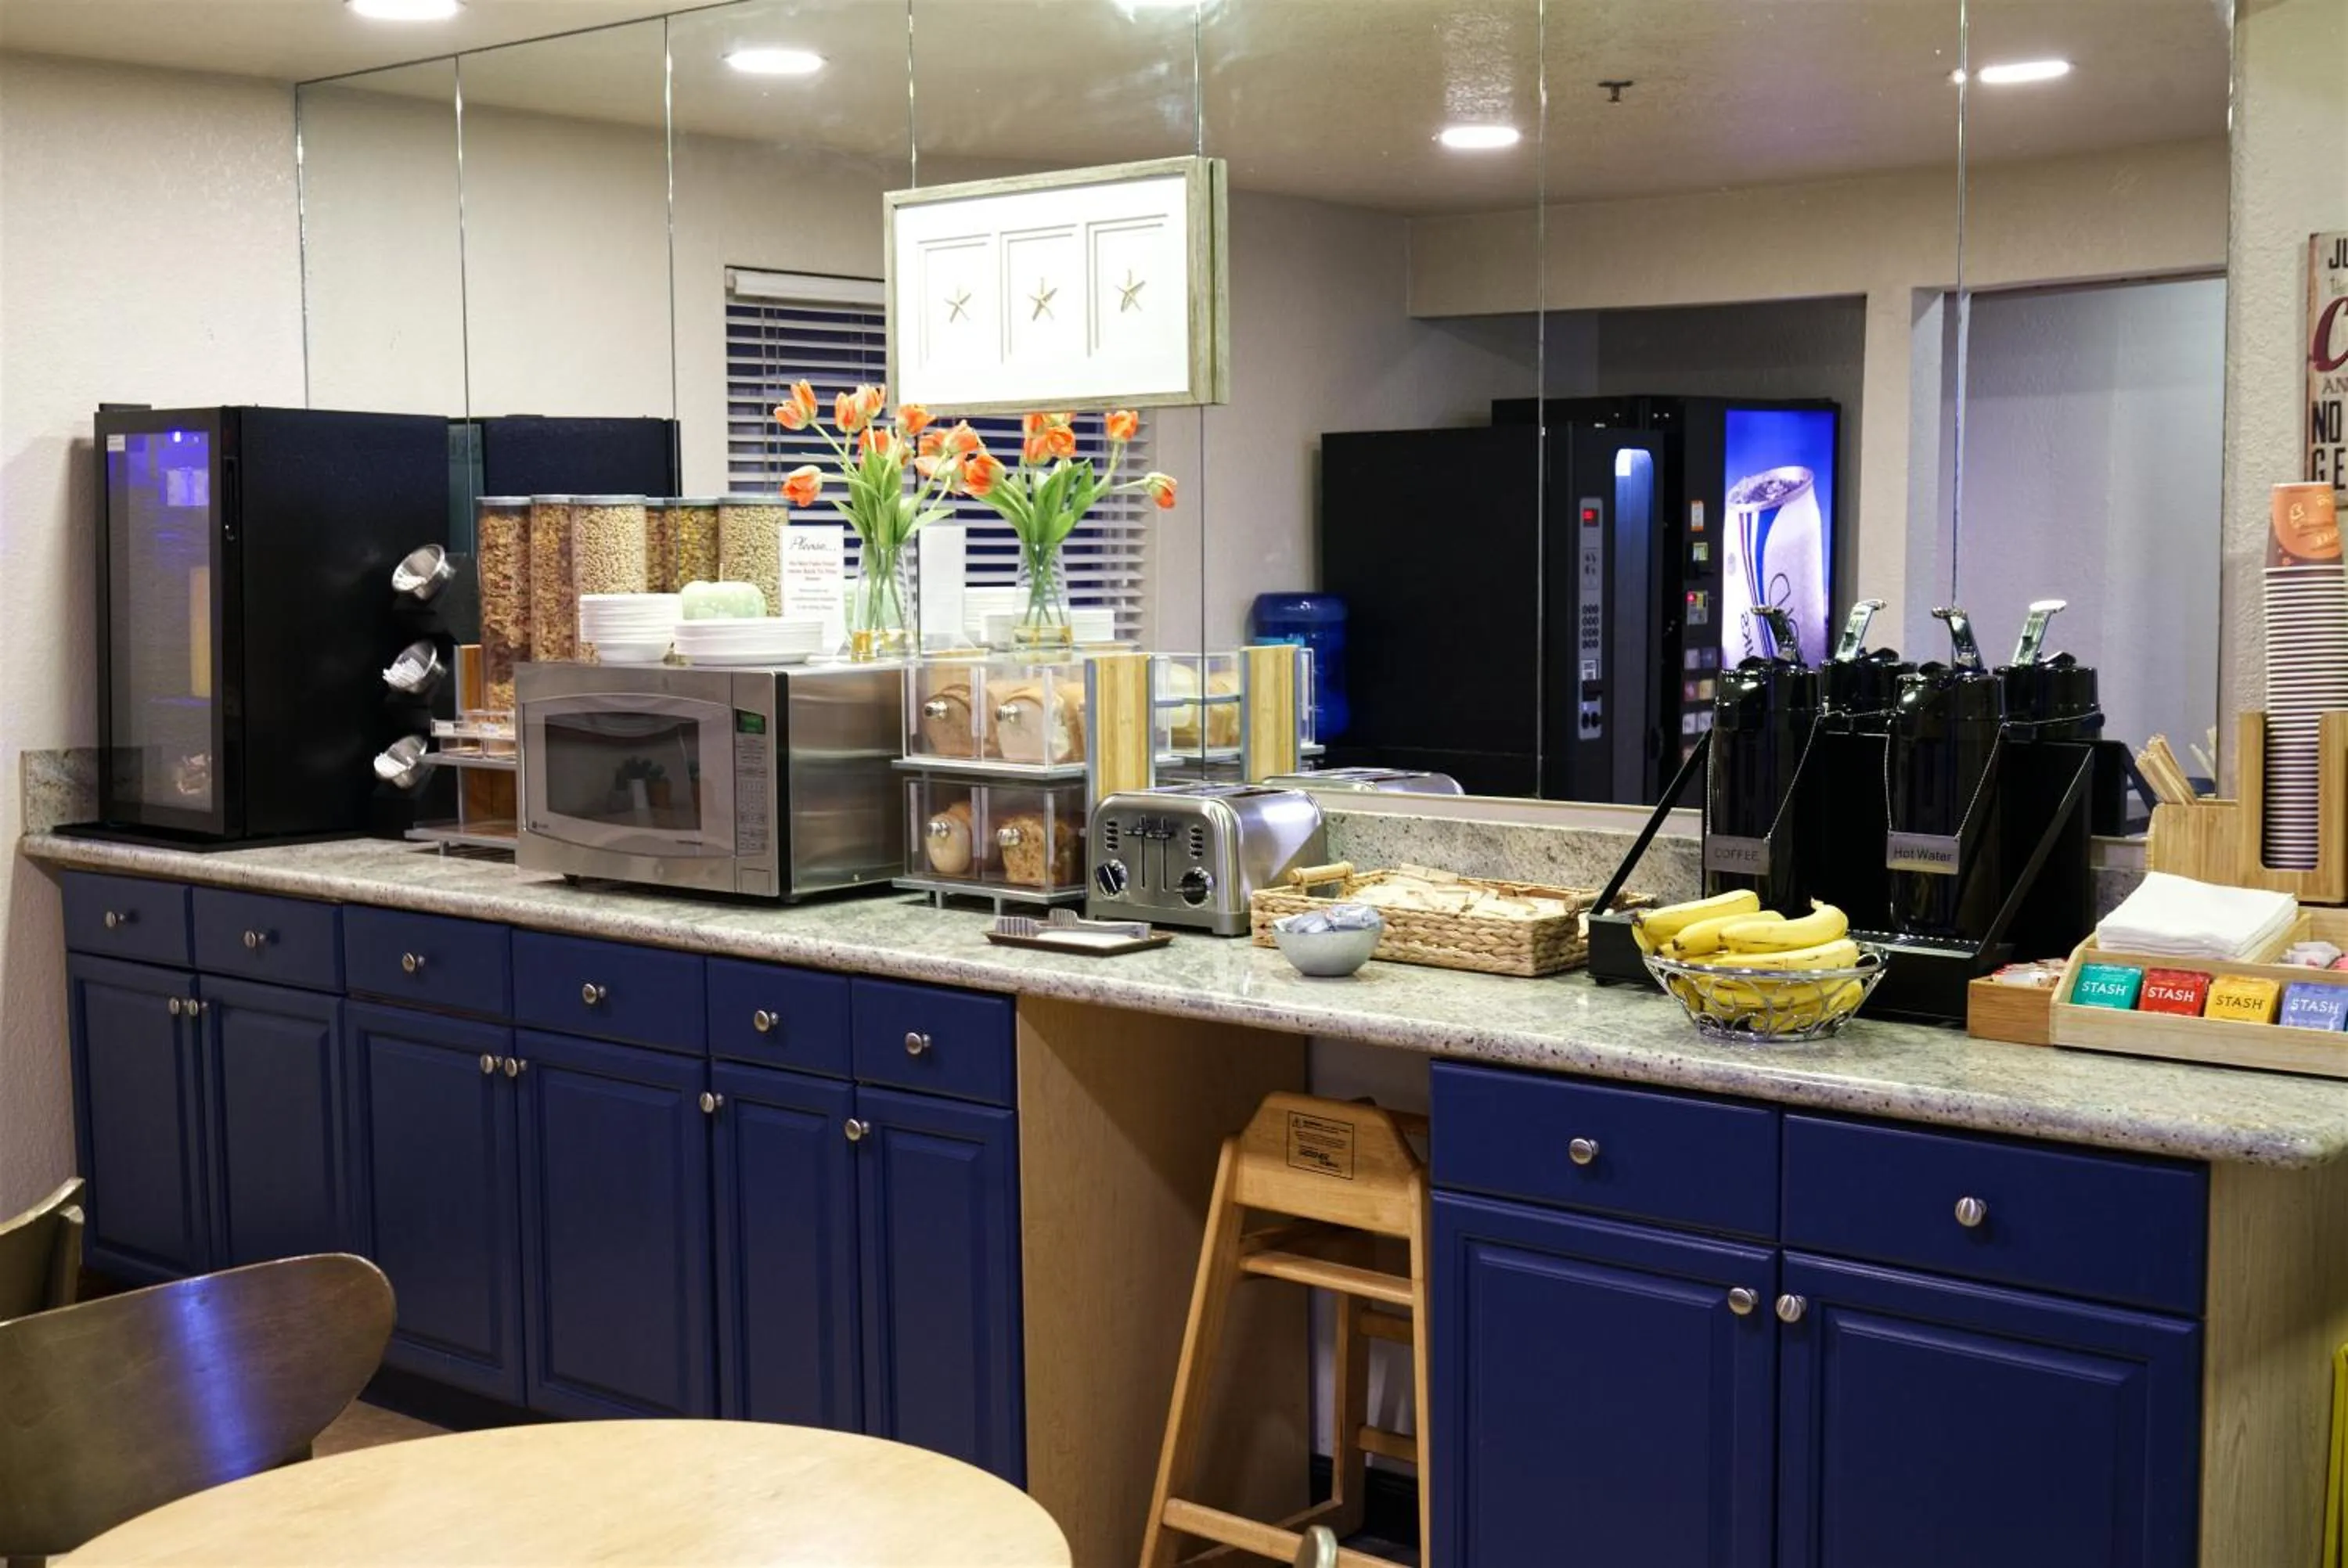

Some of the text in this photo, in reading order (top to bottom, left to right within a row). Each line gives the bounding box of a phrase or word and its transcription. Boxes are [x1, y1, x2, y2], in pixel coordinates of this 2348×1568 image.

[1715, 847, 1760, 862] COFFEE
[1894, 845, 1954, 861] Hot Water
[2081, 980, 2127, 996] STASH
[2148, 986, 2195, 1002] STASH
[2216, 994, 2263, 1010] STASH
[2290, 998, 2340, 1015] STASH
